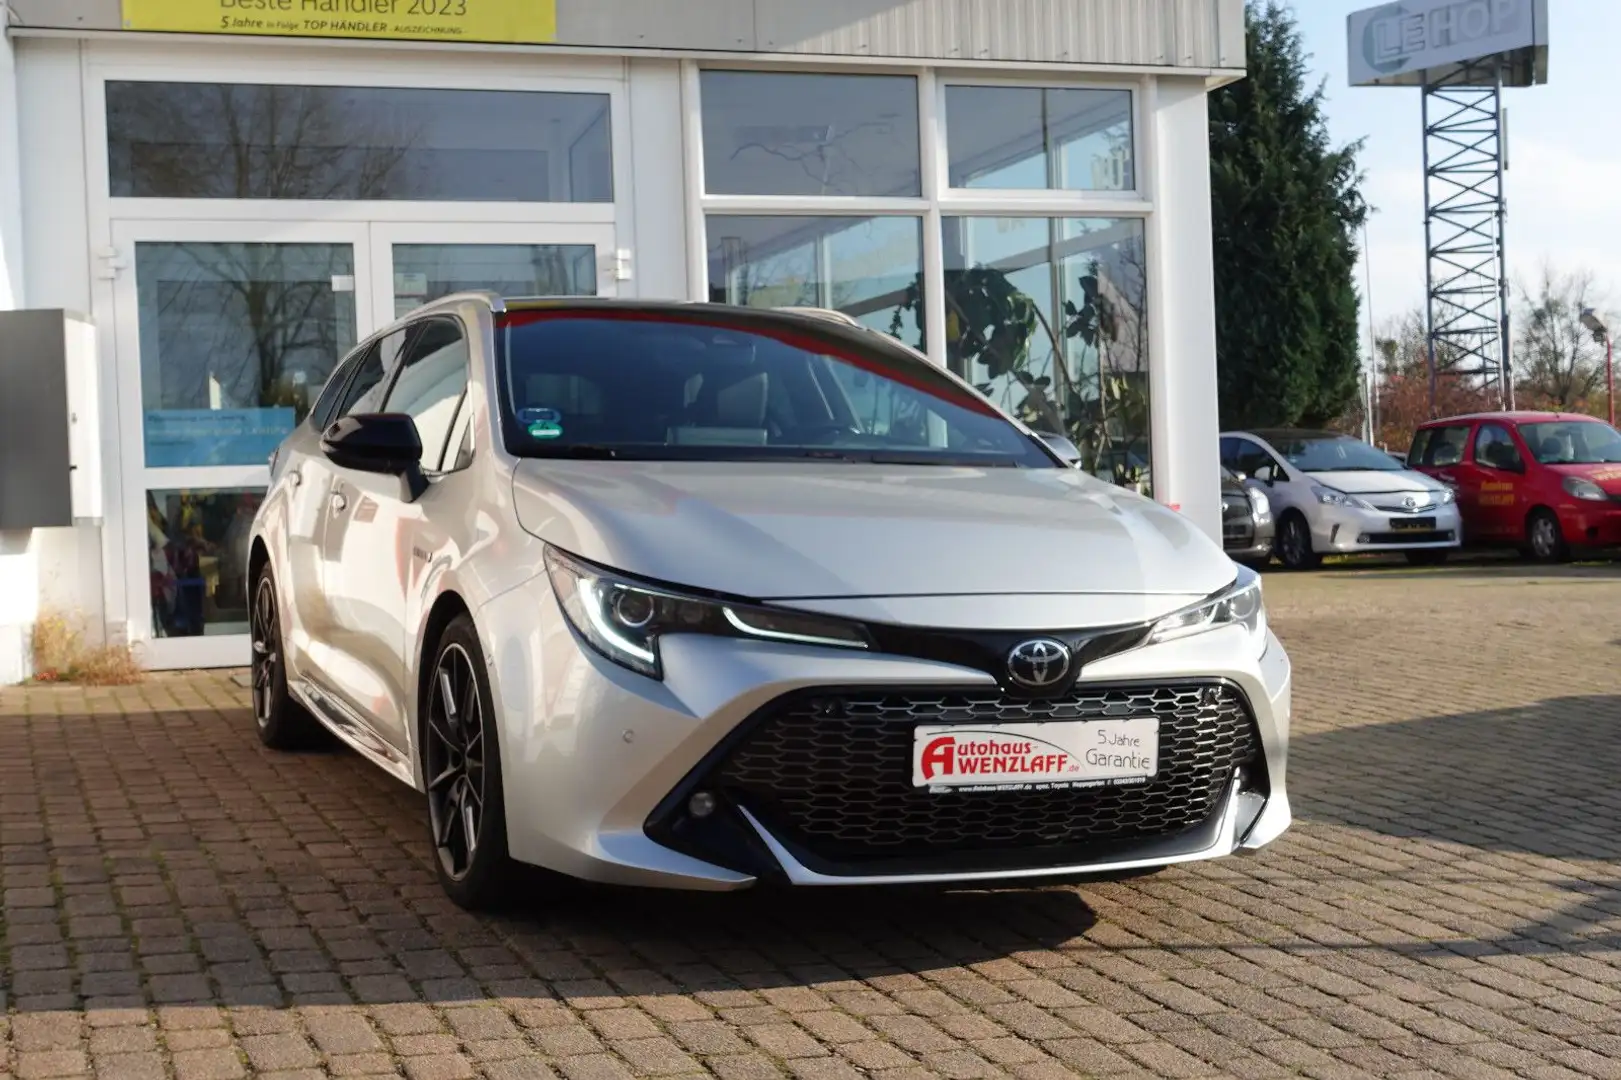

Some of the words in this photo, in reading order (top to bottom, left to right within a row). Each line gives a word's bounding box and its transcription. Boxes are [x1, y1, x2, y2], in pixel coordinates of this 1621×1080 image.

[407, 0, 467, 15] 2023
[221, 15, 230, 28] 5
[232, 16, 263, 28] Jahre
[303, 19, 328, 30] TOP
[330, 20, 388, 32] HÄNDLER
[1097, 729, 1107, 745] 5
[1108, 733, 1140, 748] Jahre
[1085, 748, 1151, 770] Garantie
